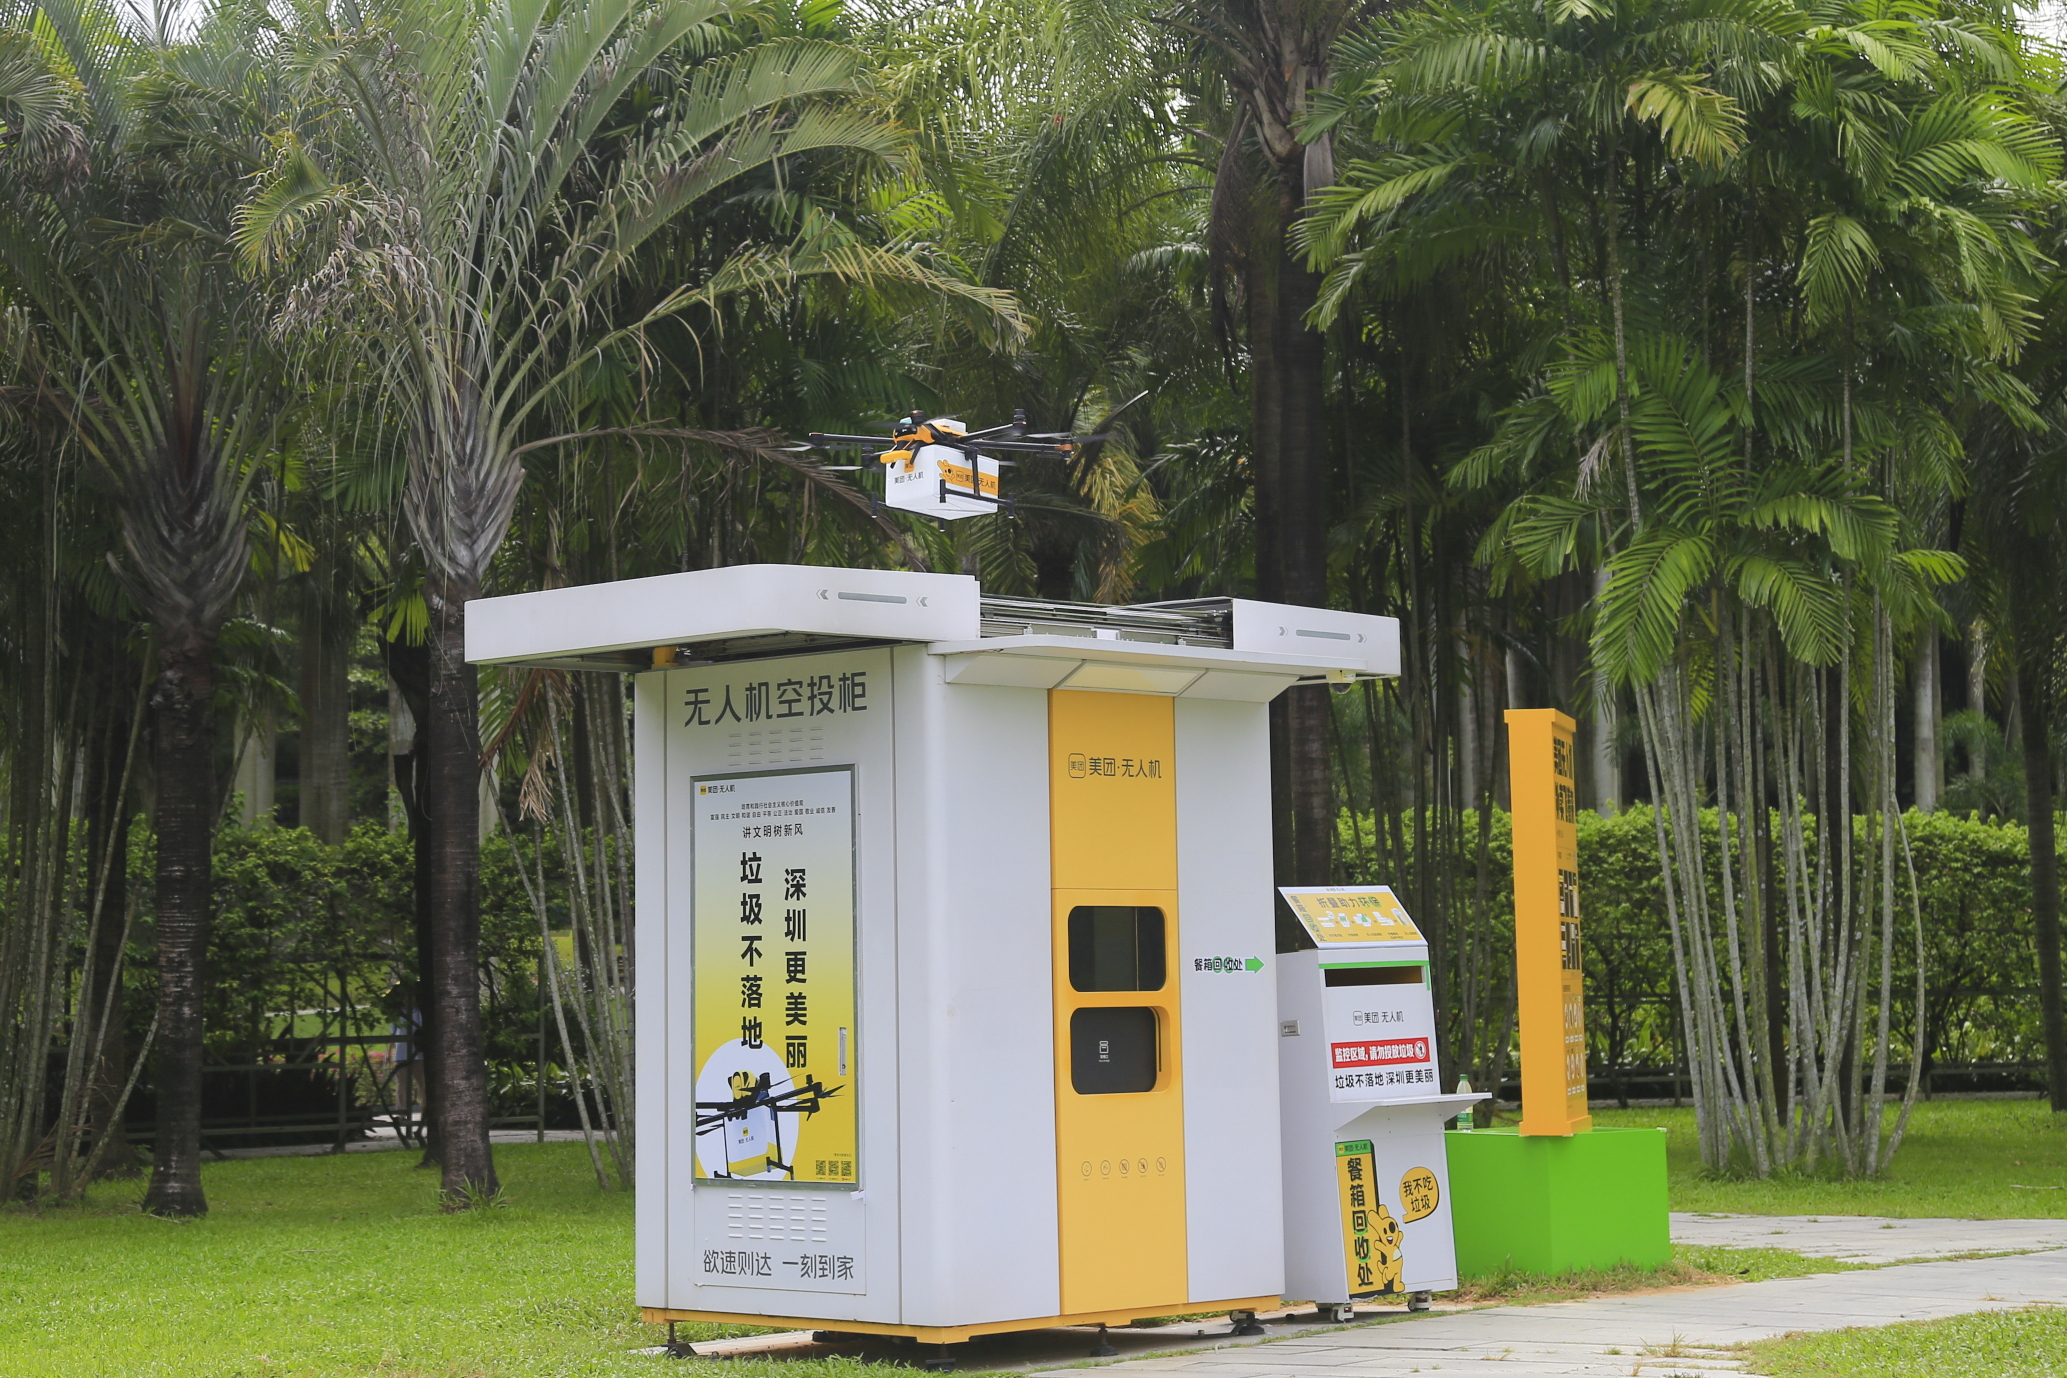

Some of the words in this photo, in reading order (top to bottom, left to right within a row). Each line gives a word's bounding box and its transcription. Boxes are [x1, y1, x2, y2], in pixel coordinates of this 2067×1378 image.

[684, 671, 868, 727] 无人机空投柜
[742, 823, 803, 839] 讲文明树新风
[740, 851, 763, 1049] 垃圾不落地
[784, 868, 808, 1068] 深圳更美丽
[1194, 957, 1243, 971] 餐箱回收处
[1335, 1072, 1384, 1089] 垃圾不落地
[1385, 1068, 1434, 1086] 深圳更美丽
[1402, 1175, 1433, 1197] 我不吃
[1410, 1194, 1431, 1212] 垃圾
[1346, 1157, 1374, 1288] 餐箱回收处
[703, 1249, 772, 1277] 欲速则达
[782, 1254, 854, 1281] 一刻到家
